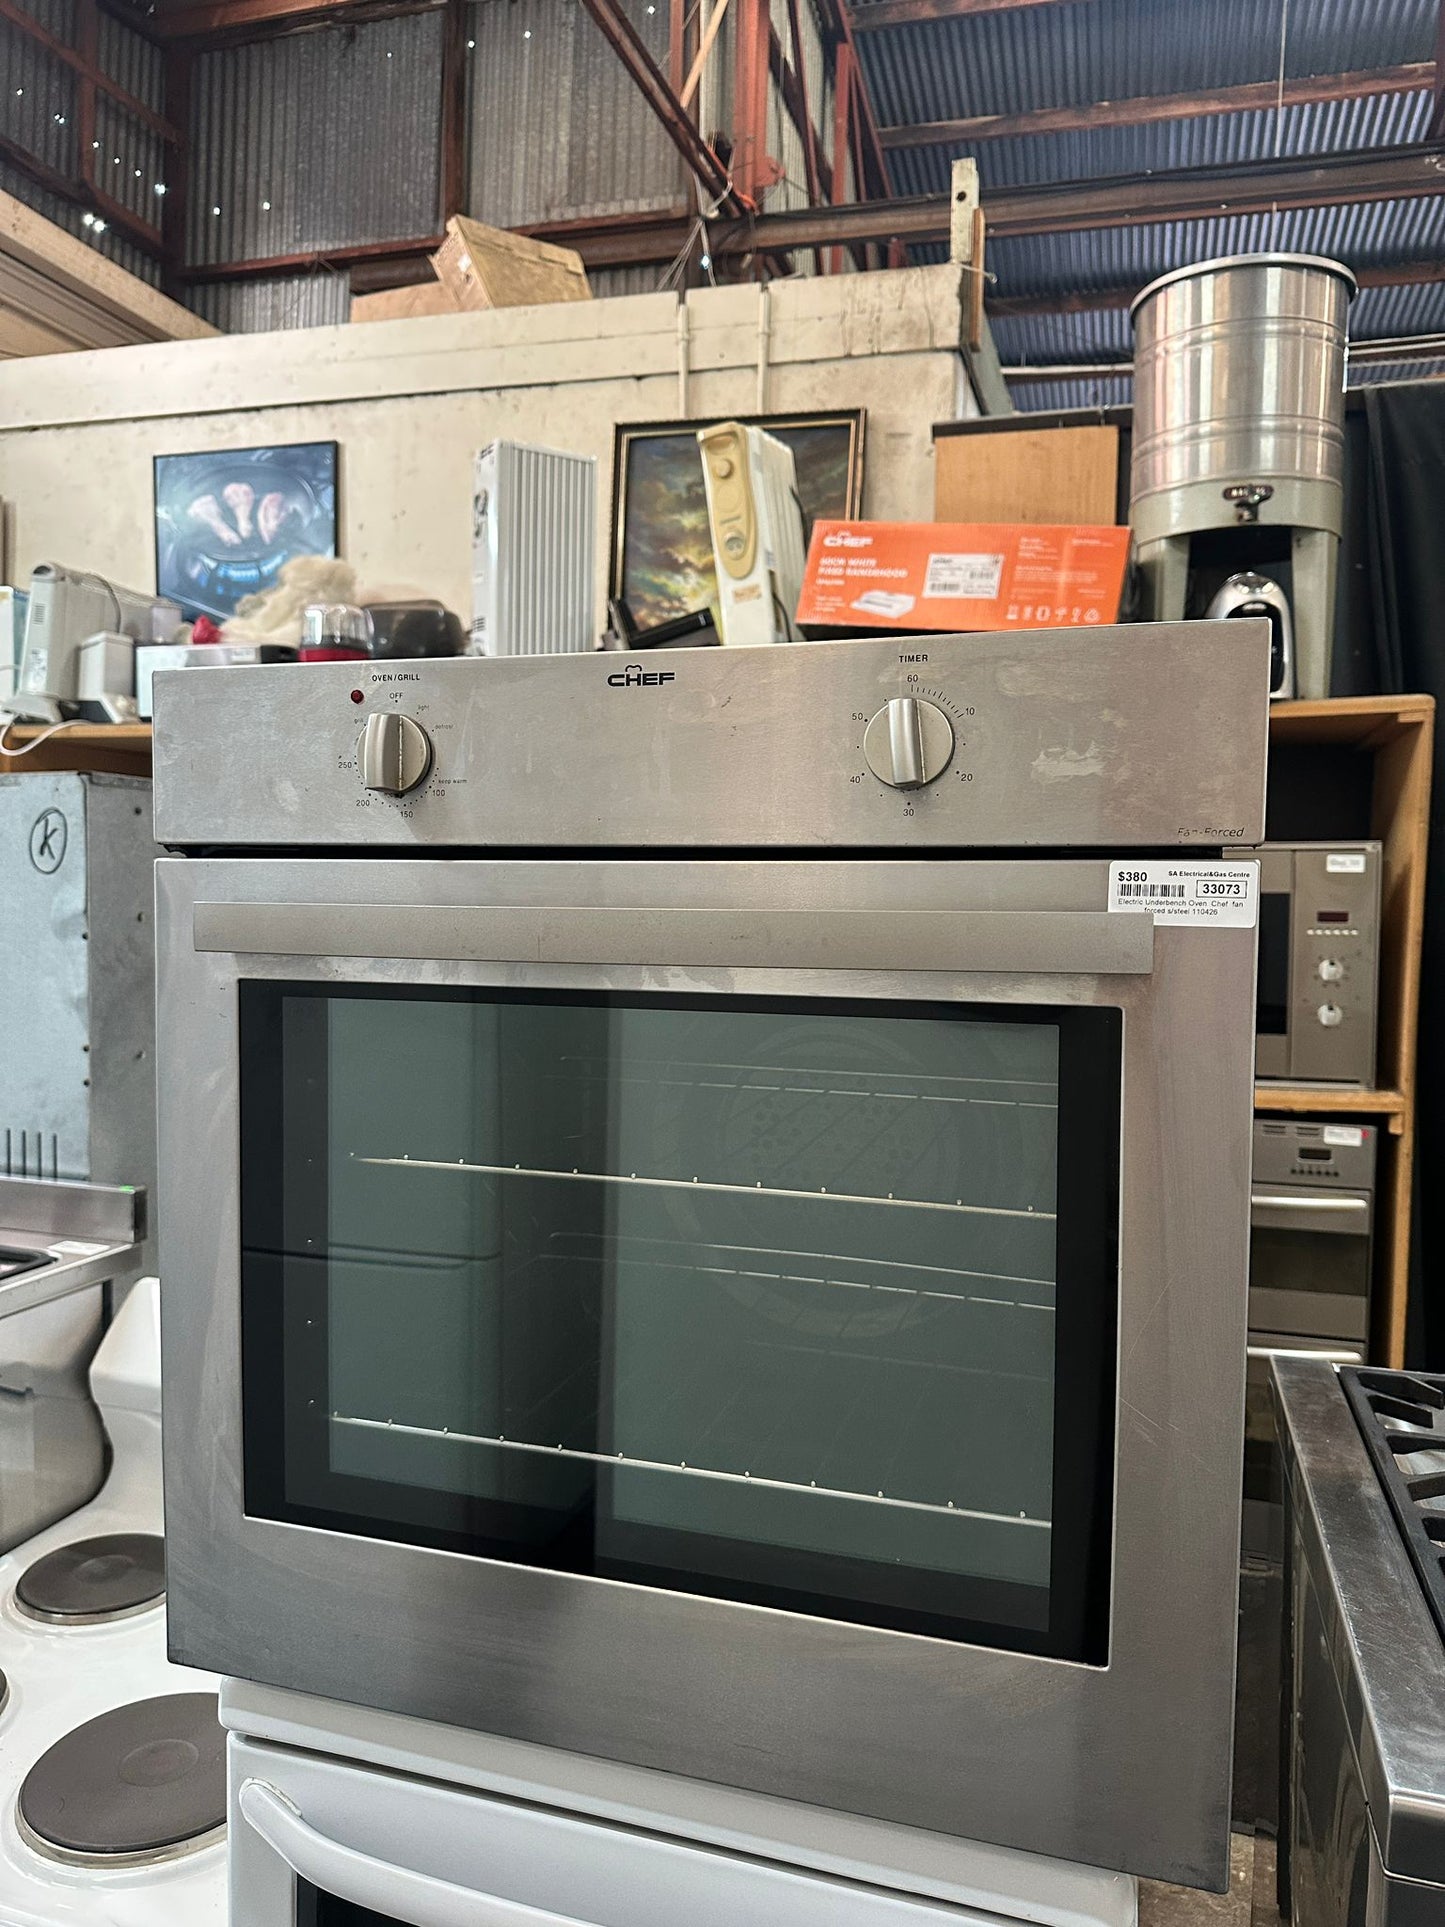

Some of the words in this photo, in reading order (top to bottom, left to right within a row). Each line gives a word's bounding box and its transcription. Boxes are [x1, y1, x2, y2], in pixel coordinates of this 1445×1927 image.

[899, 654, 928, 663] TIMER
[607, 672, 675, 687] CHEF
[907, 674, 919, 682] 60
[966, 707, 975, 715] 10
[961, 774, 972, 782] 20
[903, 809, 914, 817] 30
[1118, 871, 1148, 882] $380
[1203, 884, 1240, 895] 33073
